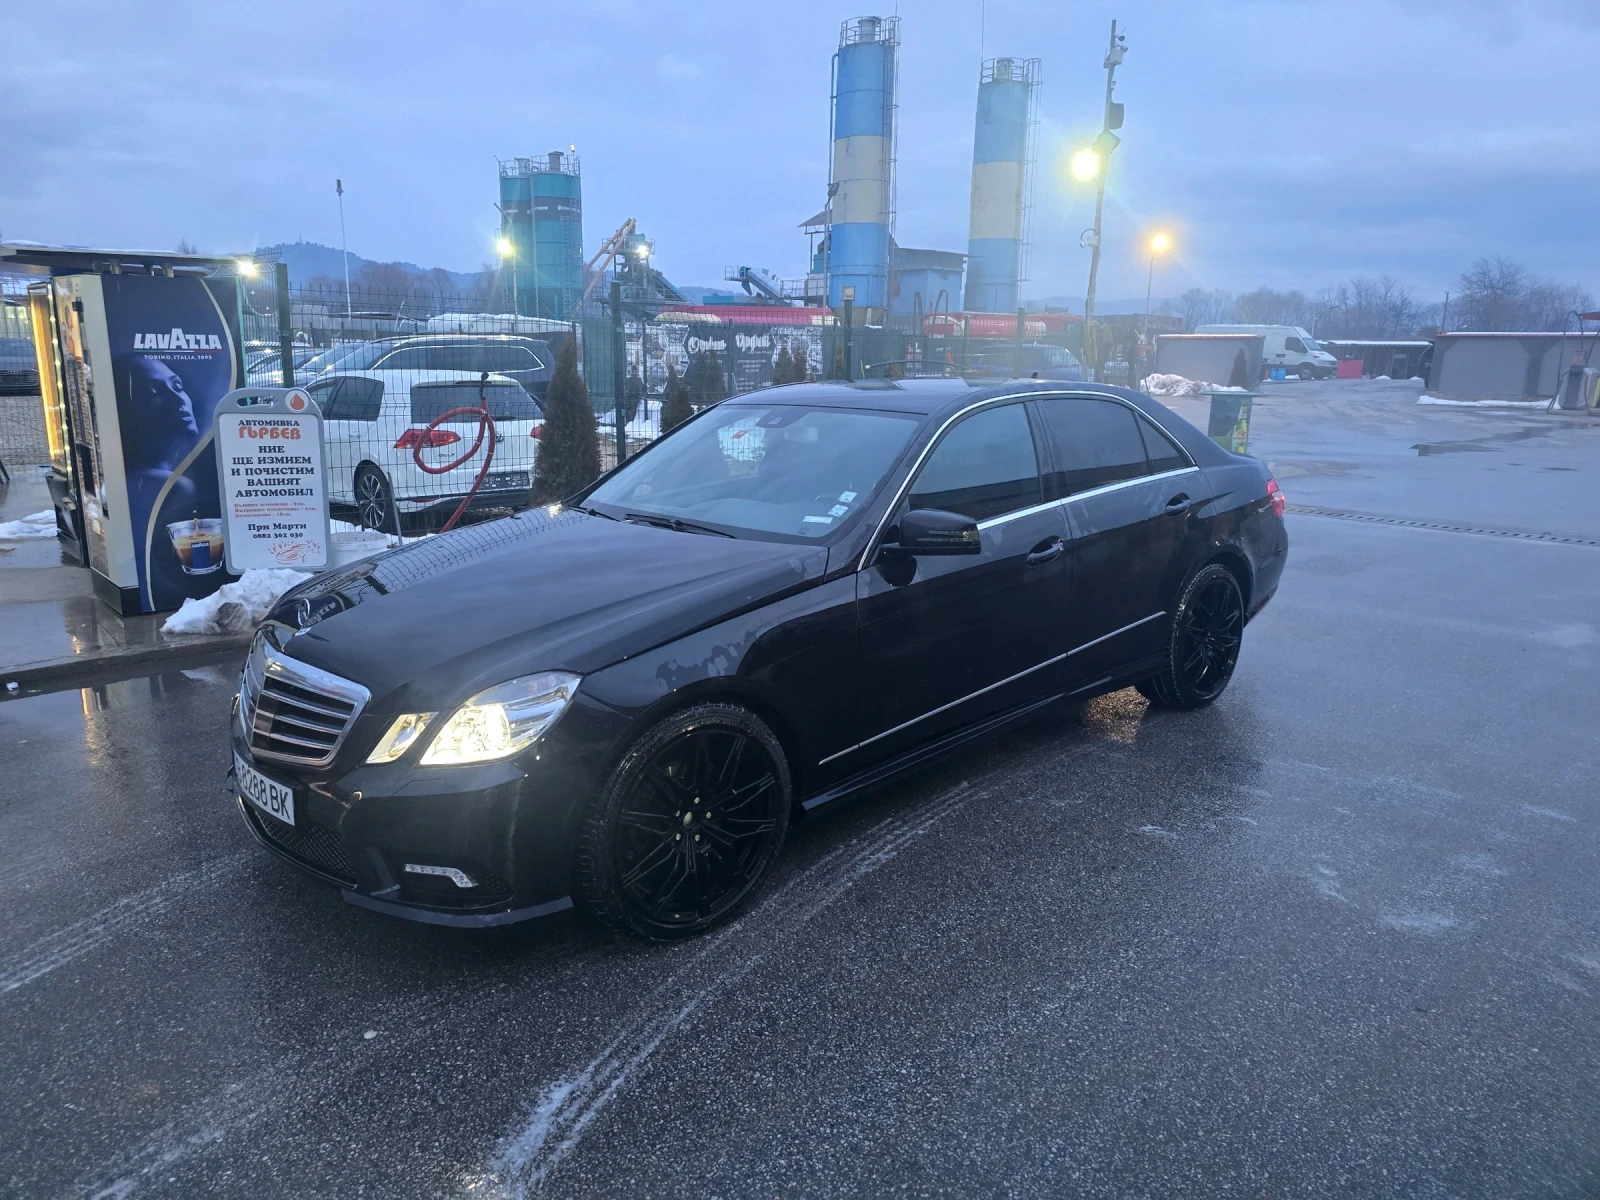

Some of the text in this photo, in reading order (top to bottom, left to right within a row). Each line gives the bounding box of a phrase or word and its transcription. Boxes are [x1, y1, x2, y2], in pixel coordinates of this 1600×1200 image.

[134, 328, 222, 349] LAVAZZA
[238, 426, 302, 440] ГЪРБЕВ
[232, 457, 254, 465] ЩЕ
[245, 467, 314, 476] ПОЧИСТИМ
[246, 478, 301, 486] ВАШИЯТ
[236, 488, 314, 498] АВТОМОБИЛ
[248, 524, 270, 532] При
